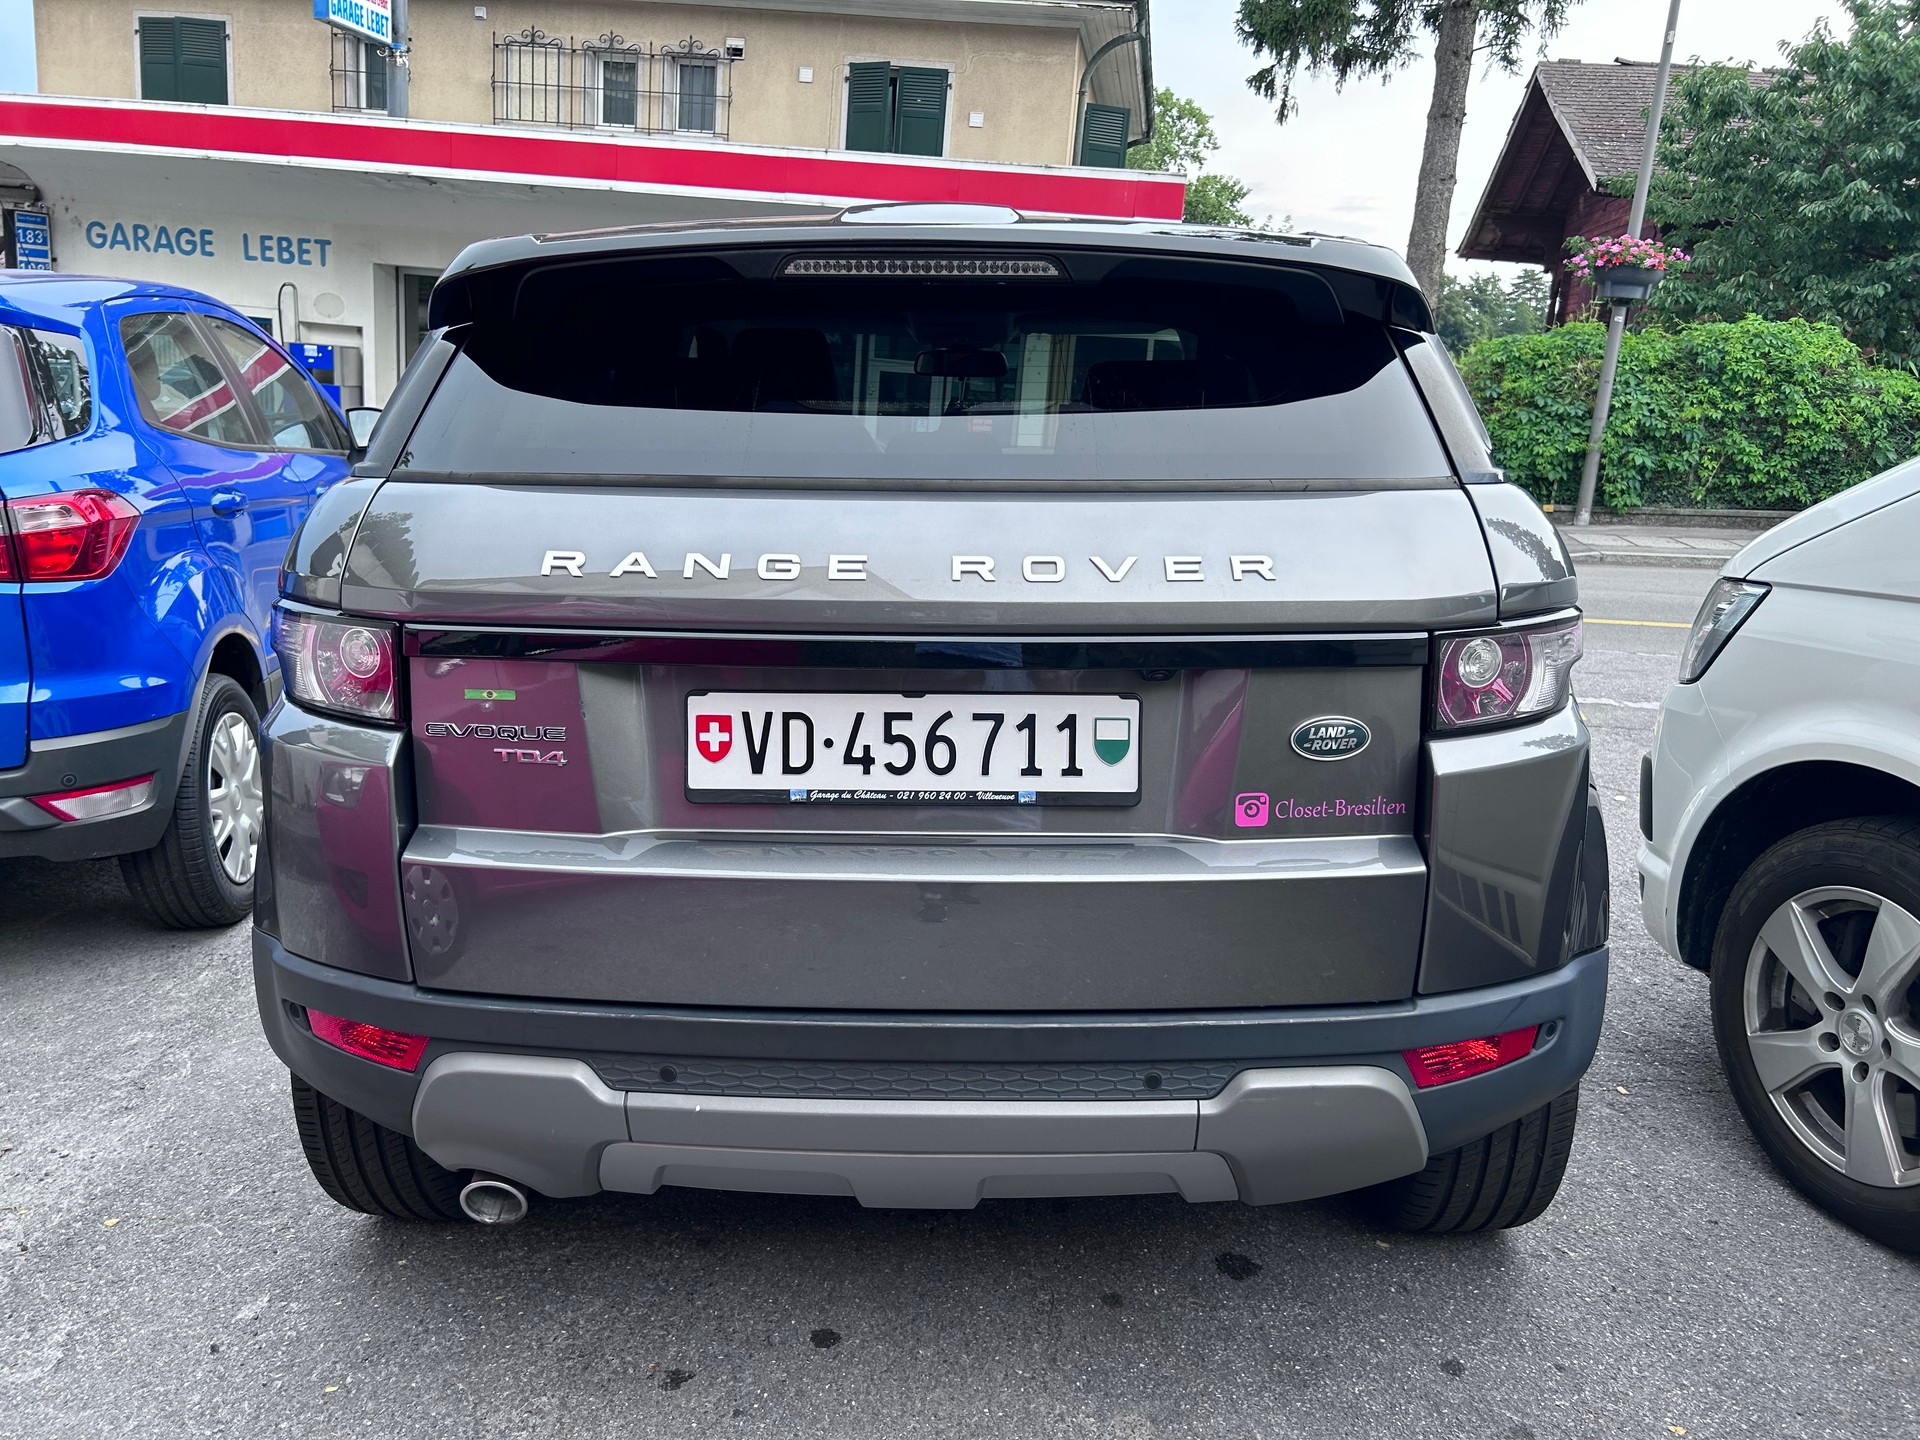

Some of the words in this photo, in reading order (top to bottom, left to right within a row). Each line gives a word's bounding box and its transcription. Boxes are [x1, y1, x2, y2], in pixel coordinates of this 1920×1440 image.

[331, 0, 364, 28] GARAGE
[366, 8, 389, 38] LEBET
[85, 221, 215, 257] GARAGE
[242, 233, 332, 267] LEBET
[541, 550, 868, 581] RANGE
[951, 554, 1277, 582] ROVER
[425, 722, 566, 742] EVOQUE
[1308, 726, 1347, 739] LAND
[1311, 738, 1358, 751] ROVER
[493, 748, 568, 767] TD4
[810, 790, 839, 801] Garage
[841, 791, 852, 799] du
[854, 789, 887, 799] Château
[896, 791, 915, 800] 021
[918, 791, 937, 800] 960
[939, 791, 951, 800] 24
[954, 791, 967, 800] 00
[976, 790, 1015, 801] Villeneuve
[1275, 796, 1407, 819] Closet-Bresilien
